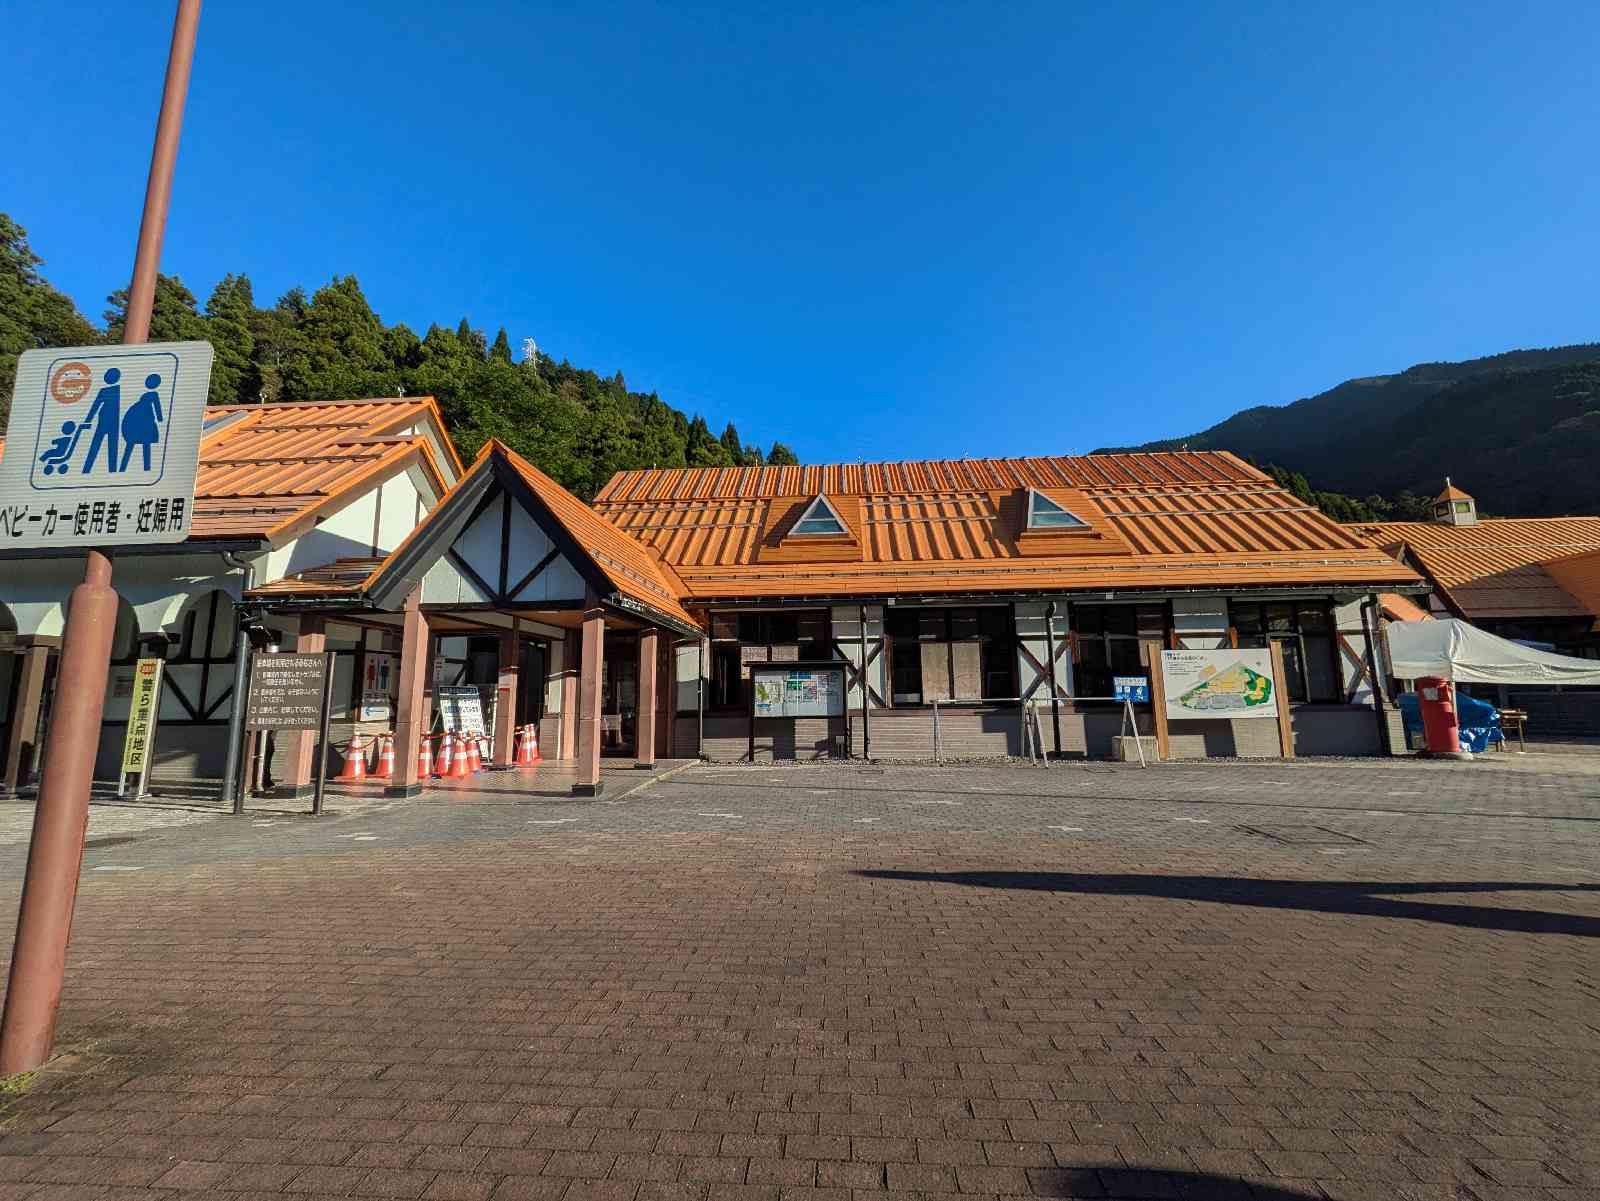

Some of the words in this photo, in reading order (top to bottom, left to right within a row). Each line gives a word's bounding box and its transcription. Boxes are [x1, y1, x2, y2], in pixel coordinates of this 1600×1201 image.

[0, 498, 185, 537] ベビーカー使用者・妊婦用
